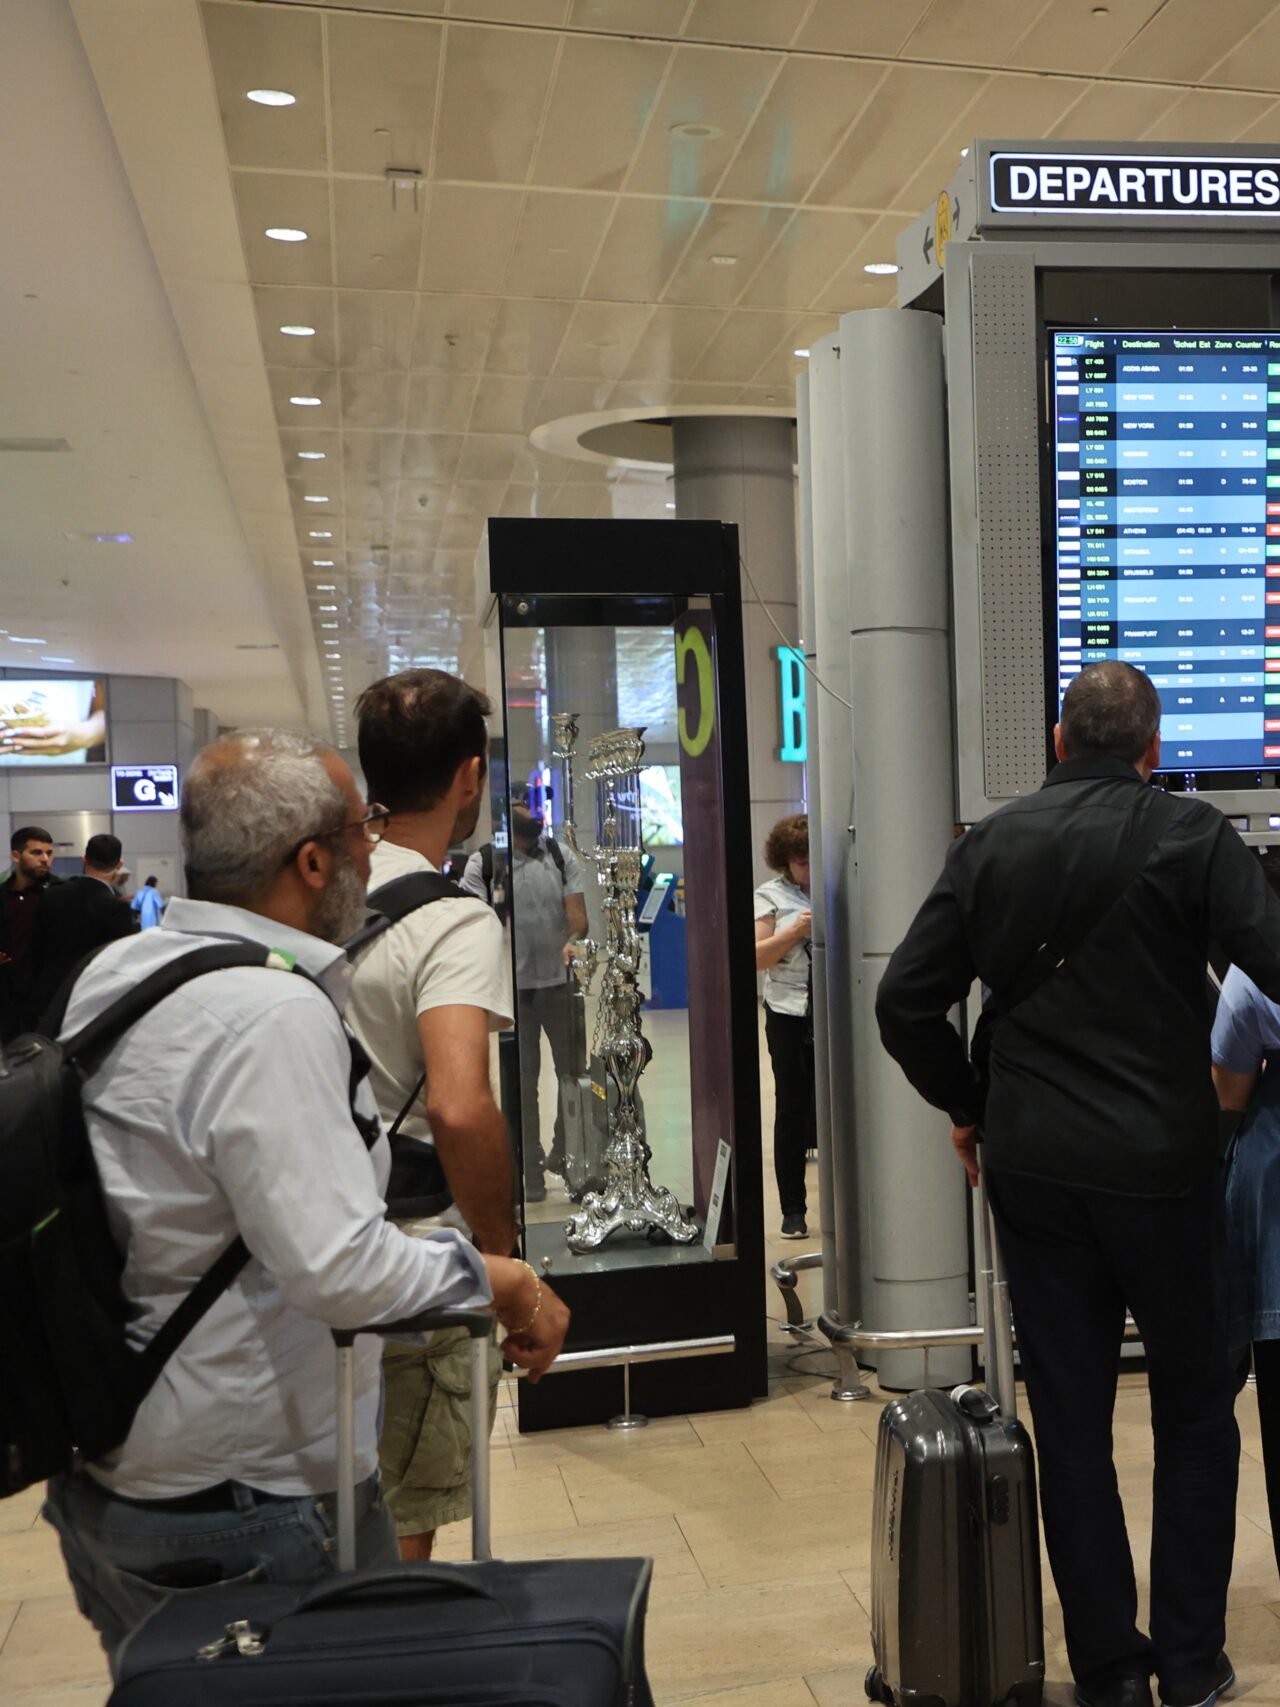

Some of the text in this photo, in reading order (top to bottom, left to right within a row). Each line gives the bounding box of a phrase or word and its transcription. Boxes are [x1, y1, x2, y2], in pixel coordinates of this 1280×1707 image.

[1009, 165, 1280, 204] DEPARTURES
[1085, 341, 1104, 349] Flight
[1122, 341, 1160, 349] Destination
[1176, 341, 1197, 349] Sched
[1199, 341, 1211, 349] Est
[1215, 341, 1232, 349] Zone
[1236, 341, 1262, 349] Counter
[134, 779, 157, 801] G
